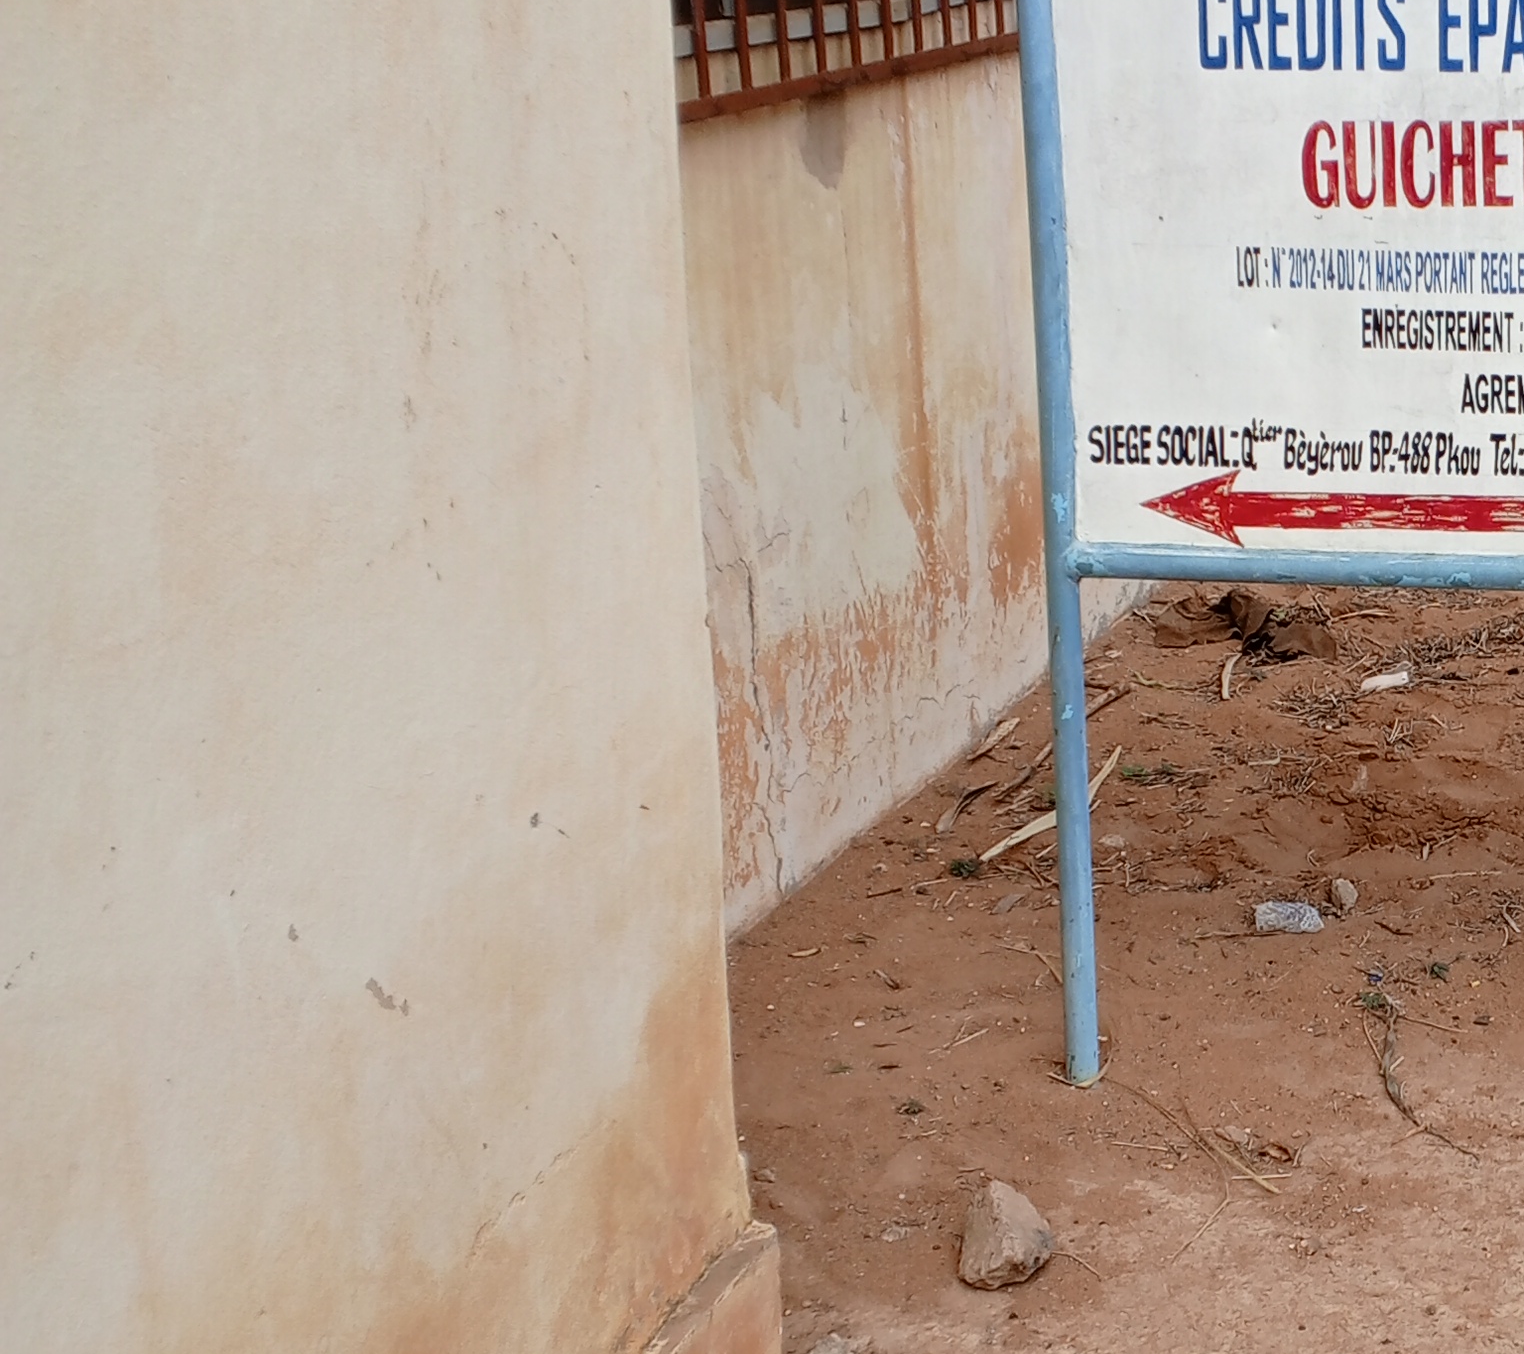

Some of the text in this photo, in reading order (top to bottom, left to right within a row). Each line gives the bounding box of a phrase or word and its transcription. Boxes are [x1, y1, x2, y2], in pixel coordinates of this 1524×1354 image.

[1357, 249, 1371, 291] 21
[1375, 250, 1412, 292] MARS
[1415, 251, 1476, 294] PORTANT
[1088, 424, 1152, 466] SIEGE
